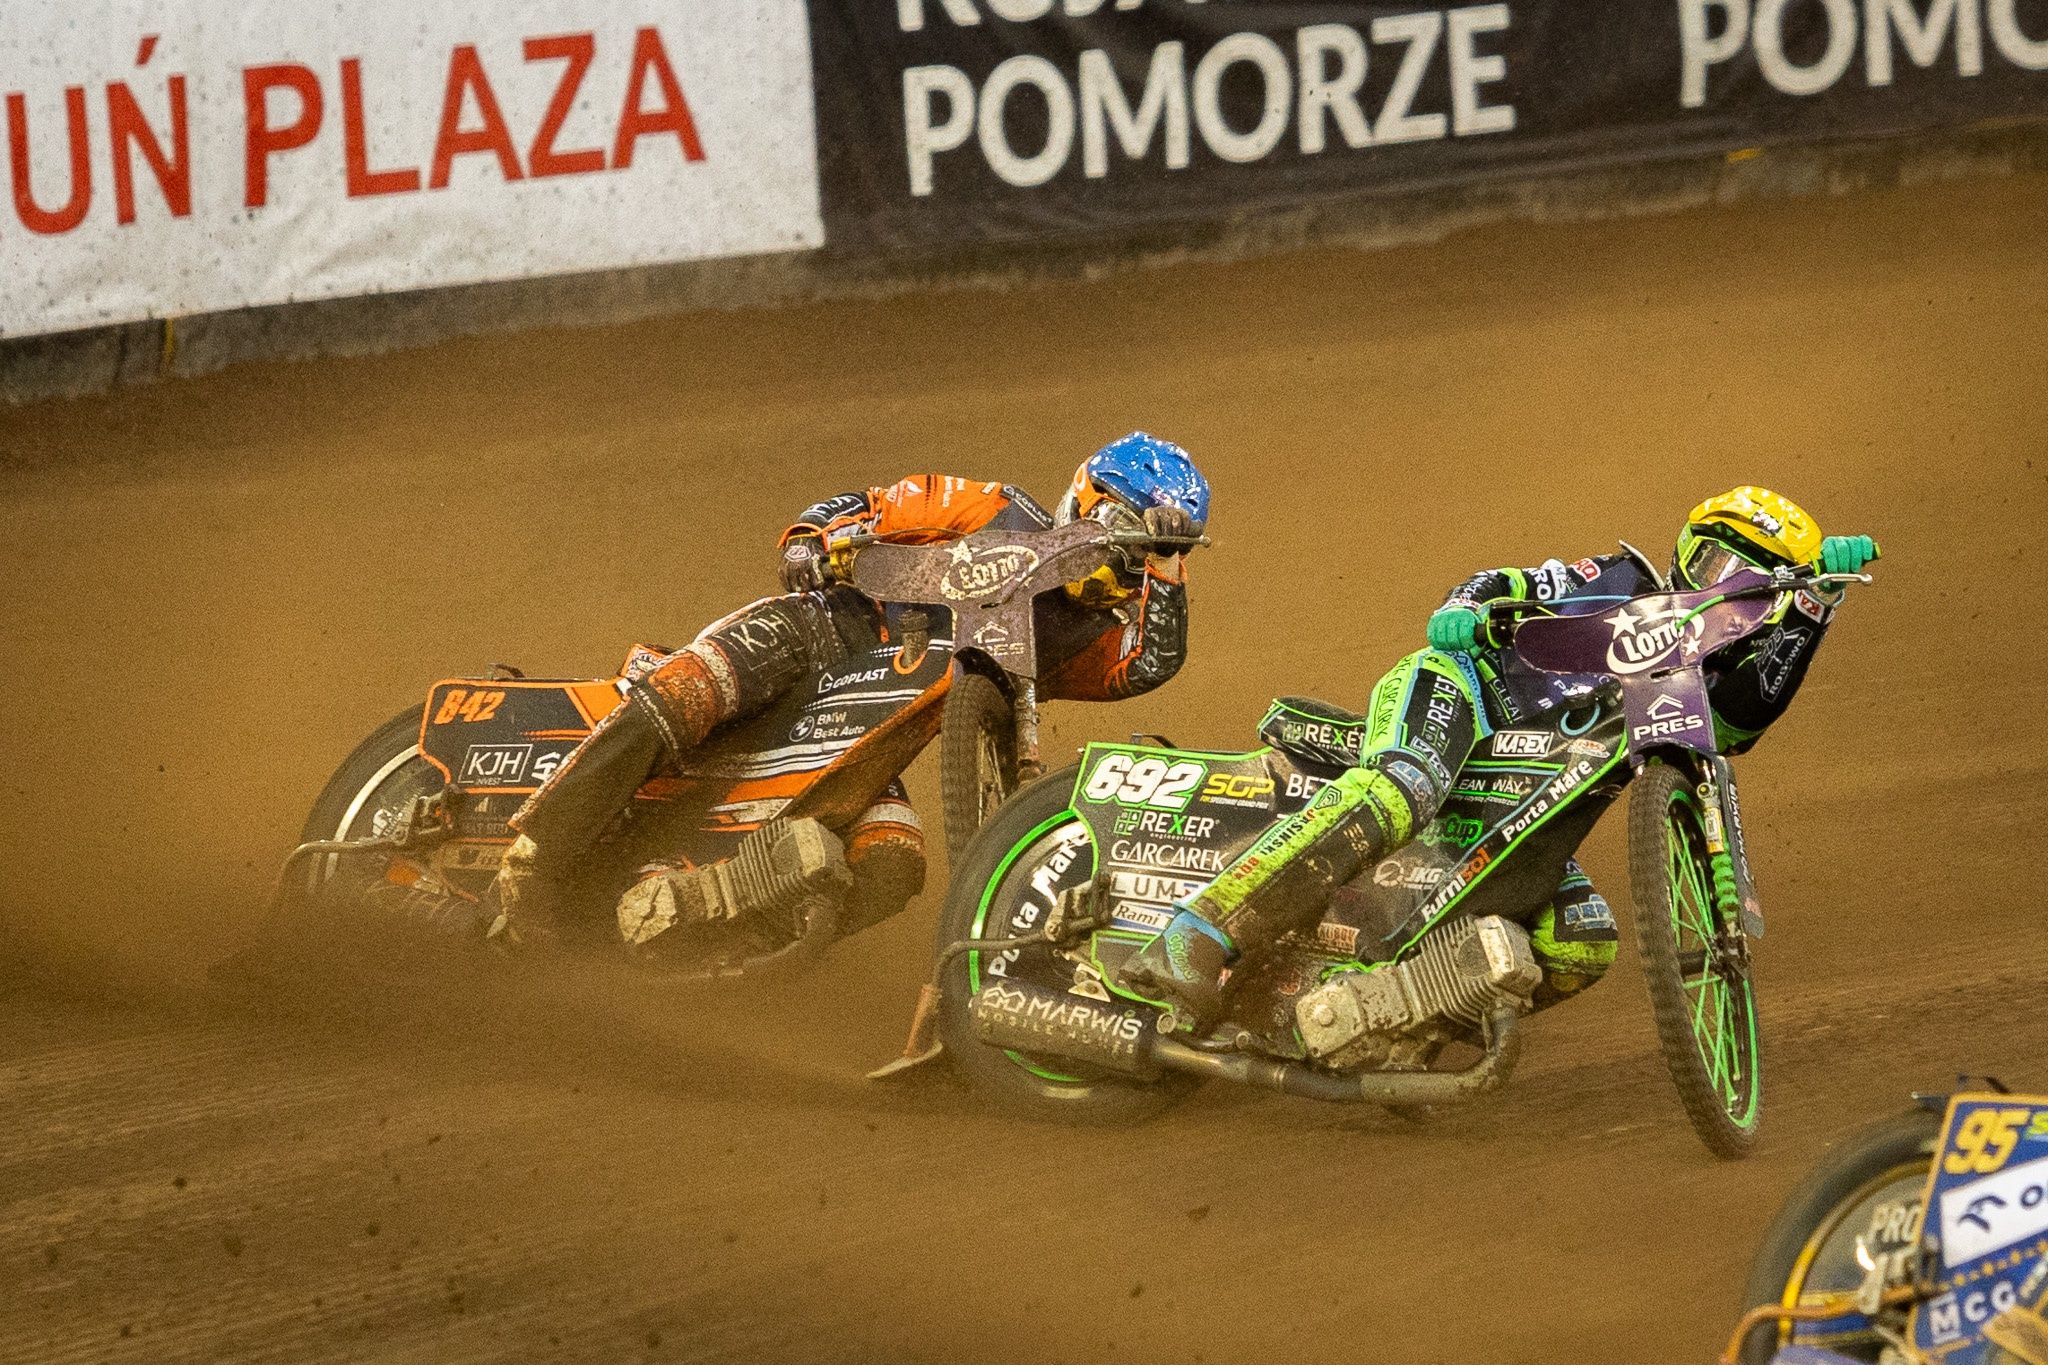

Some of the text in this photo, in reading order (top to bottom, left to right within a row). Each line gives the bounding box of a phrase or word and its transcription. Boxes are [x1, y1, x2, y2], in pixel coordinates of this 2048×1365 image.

[902, 4, 1516, 197] POMORZE
[6, 25, 706, 235] UŃ PLAZA
[1621, 619, 1686, 662] LOTTO
[433, 689, 506, 725] 842
[817, 711, 847, 726] BMW
[1493, 733, 1552, 755] KAREX
[1633, 714, 1704, 741] PRES
[467, 751, 524, 776] KJH
[1082, 752, 1206, 810] 692
[1202, 773, 1276, 799] SGP
[1492, 778, 1524, 795] WAY
[1501, 760, 1594, 843] Porta Mare
[1140, 811, 1215, 838] REXER
[1111, 839, 1230, 872] GARCAREK
[1116, 904, 1160, 926] Rami
[1026, 996, 1144, 1041] MARWIS
[1944, 1107, 2032, 1174] 95
